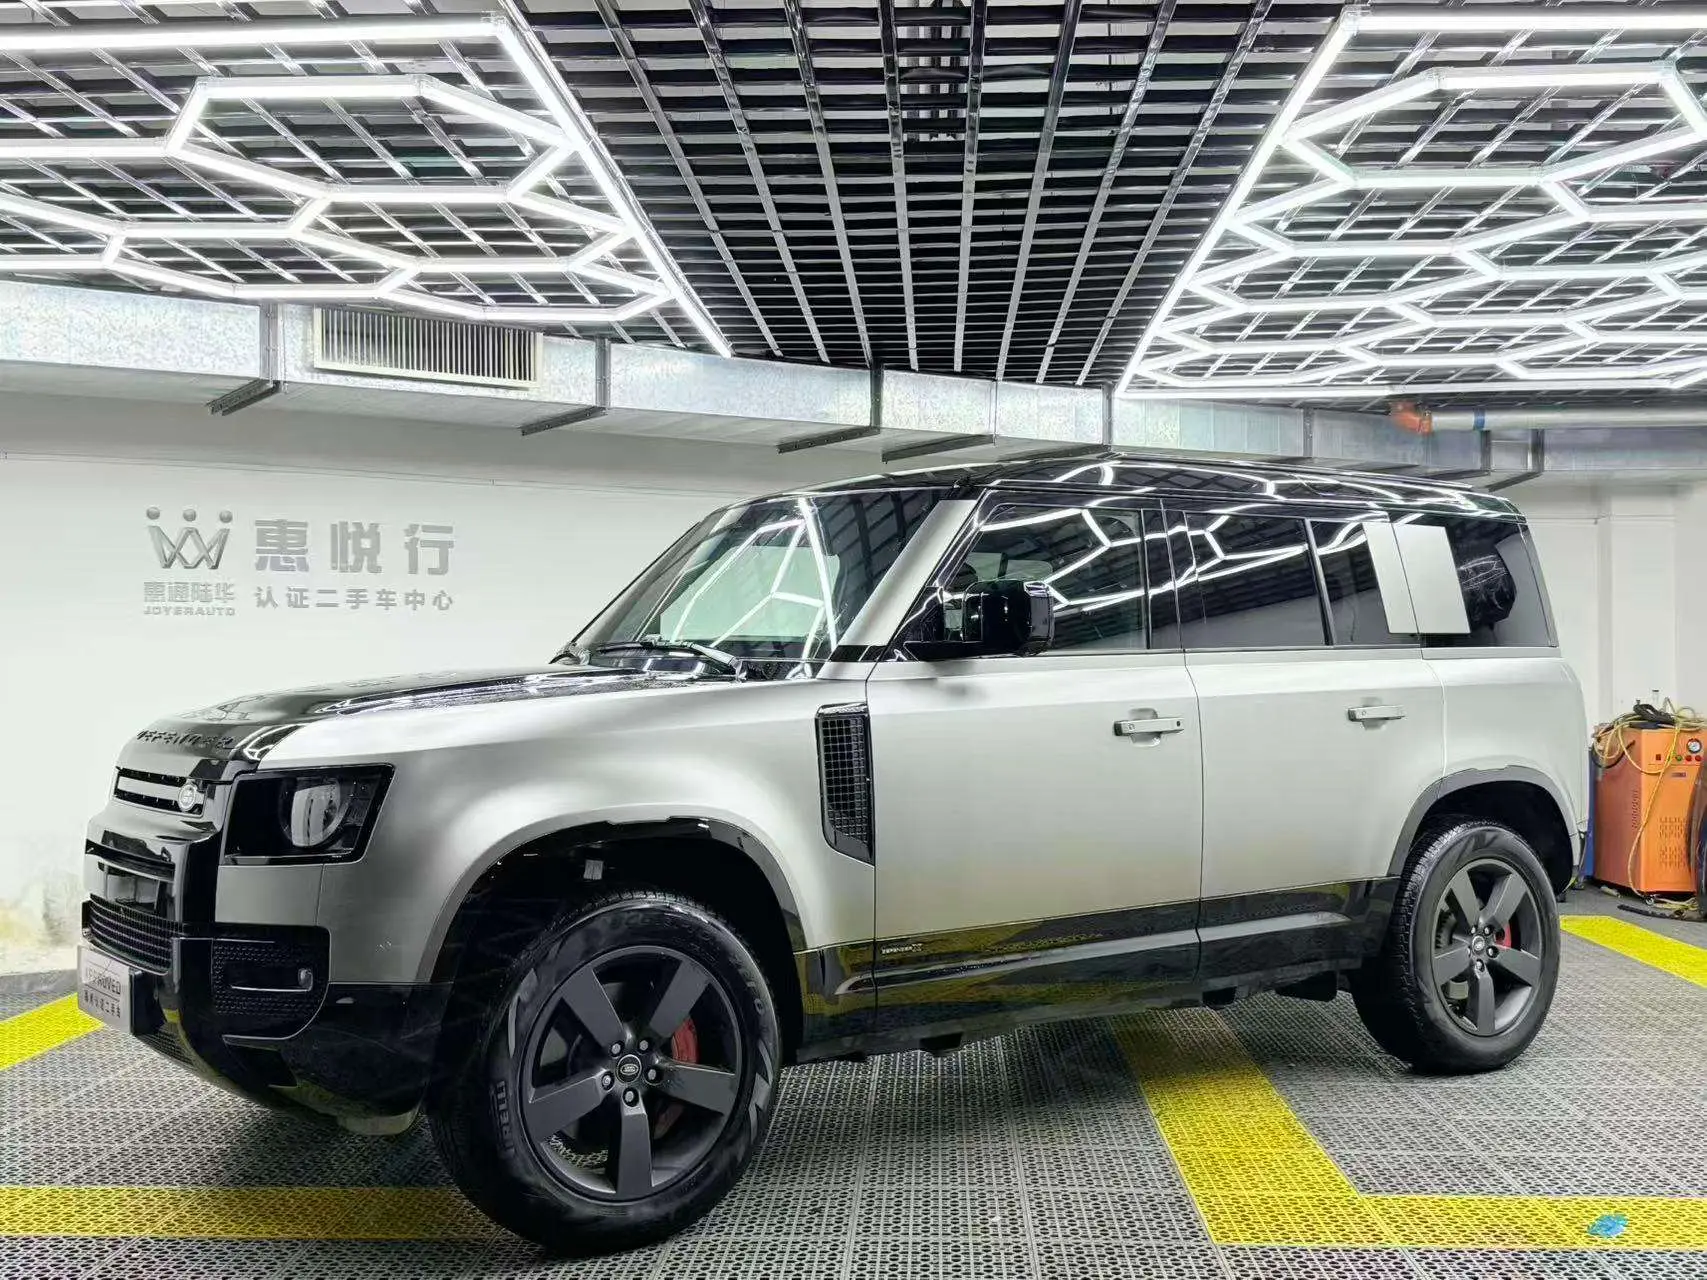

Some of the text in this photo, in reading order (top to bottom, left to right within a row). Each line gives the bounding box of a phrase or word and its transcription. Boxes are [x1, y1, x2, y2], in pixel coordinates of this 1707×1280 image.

[255, 519, 454, 575] 惠悦行
[255, 586, 453, 611] 认证二手车中心
